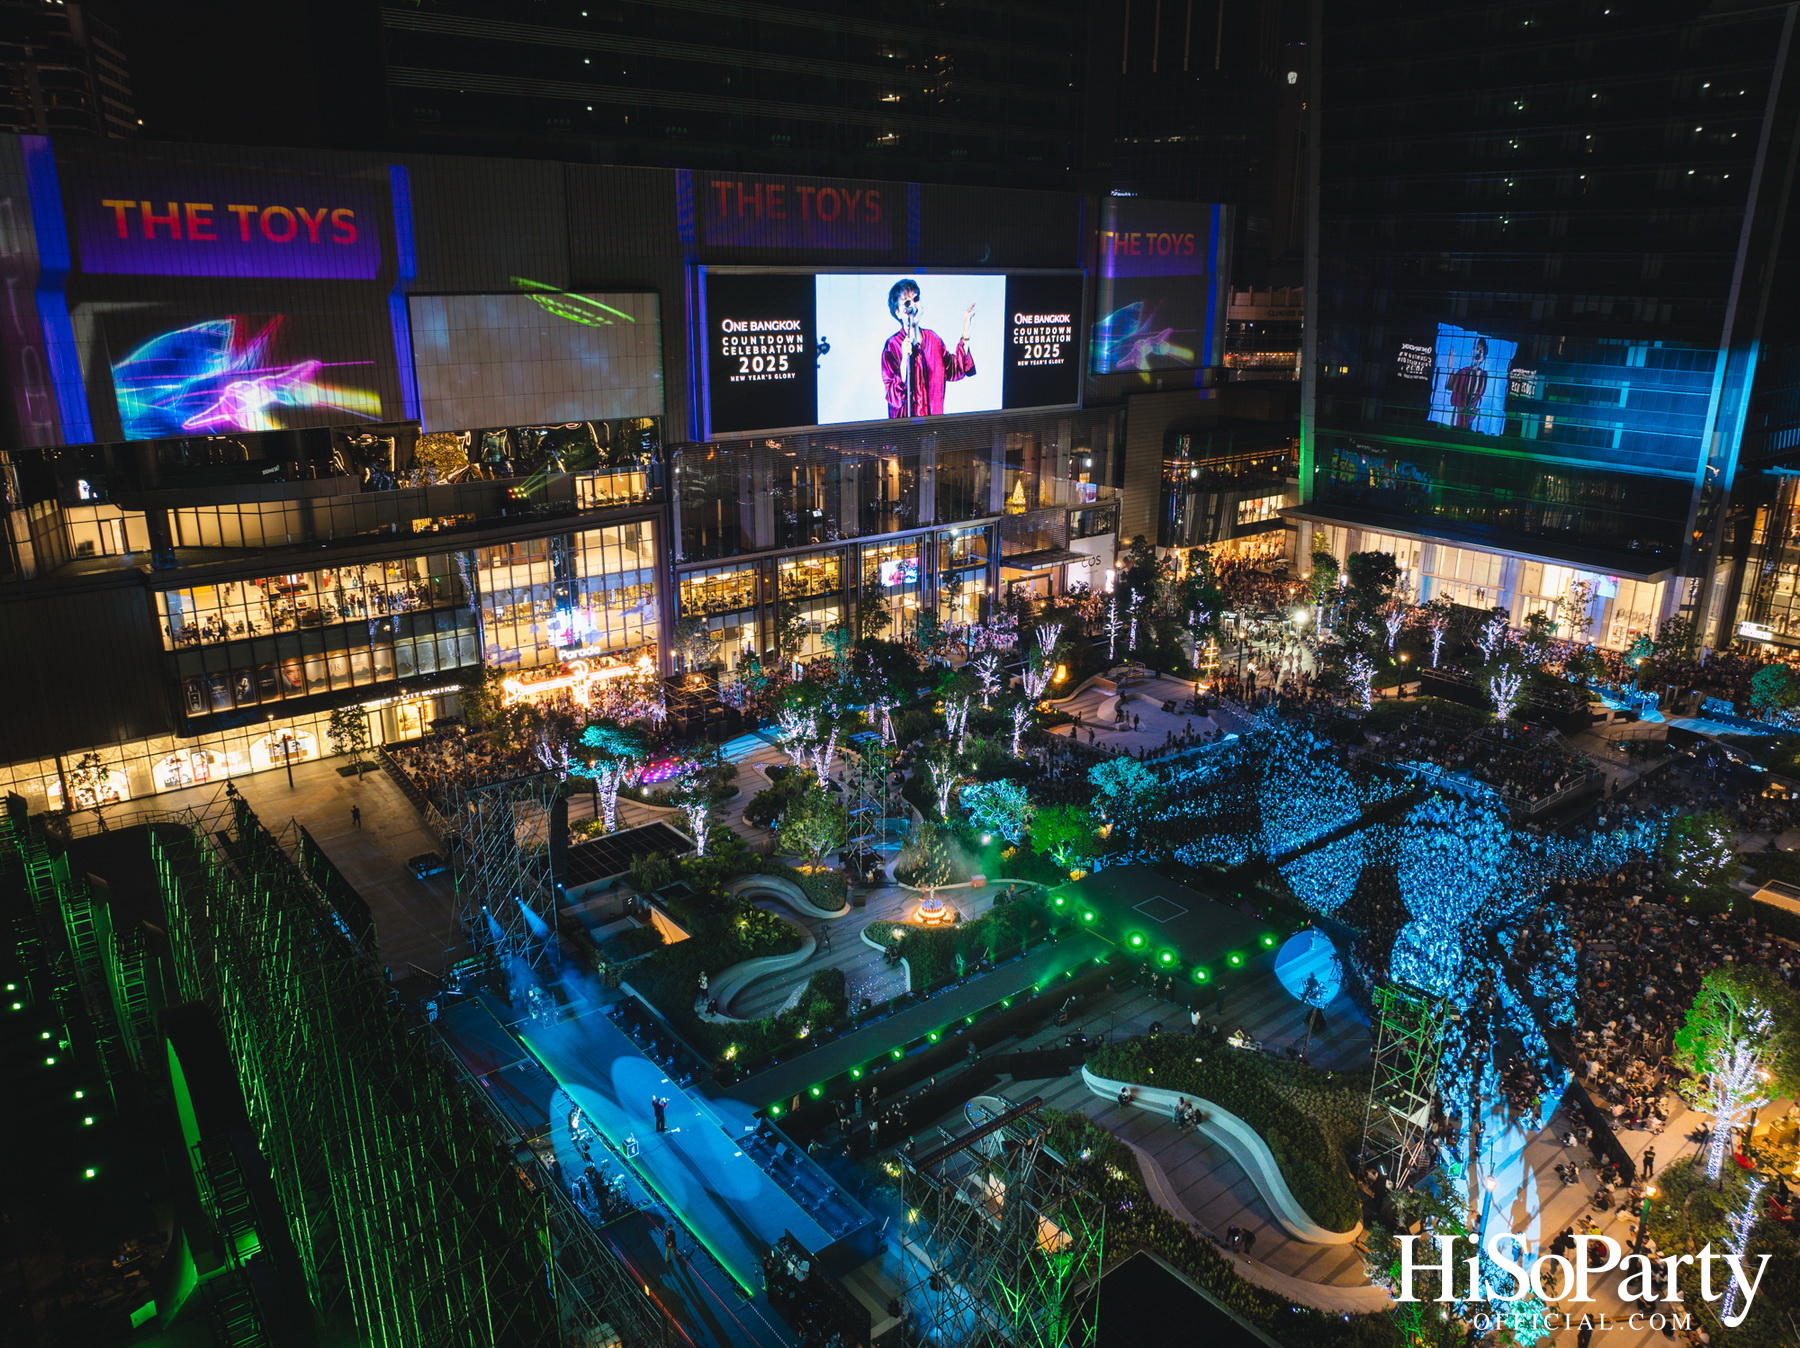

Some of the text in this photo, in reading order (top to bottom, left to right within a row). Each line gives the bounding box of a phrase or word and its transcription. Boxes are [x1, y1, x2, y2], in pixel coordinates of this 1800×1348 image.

[711, 180, 882, 224] THE TOYS
[102, 199, 358, 245] THE TOYS
[1096, 230, 1195, 256] THE TOYS
[722, 319, 801, 333] ONE BANGKOK
[1014, 313, 1071, 325] ONE BANGKOK
[1014, 327, 1072, 335] COUNTDOWN
[722, 335, 803, 346] COUNTDOWN
[1014, 335, 1071, 344] CELEBRATION
[722, 344, 803, 355] CELEBRATION
[1024, 344, 1060, 359] 2025
[739, 355, 789, 374] 2025
[559, 645, 601, 661] Parade
